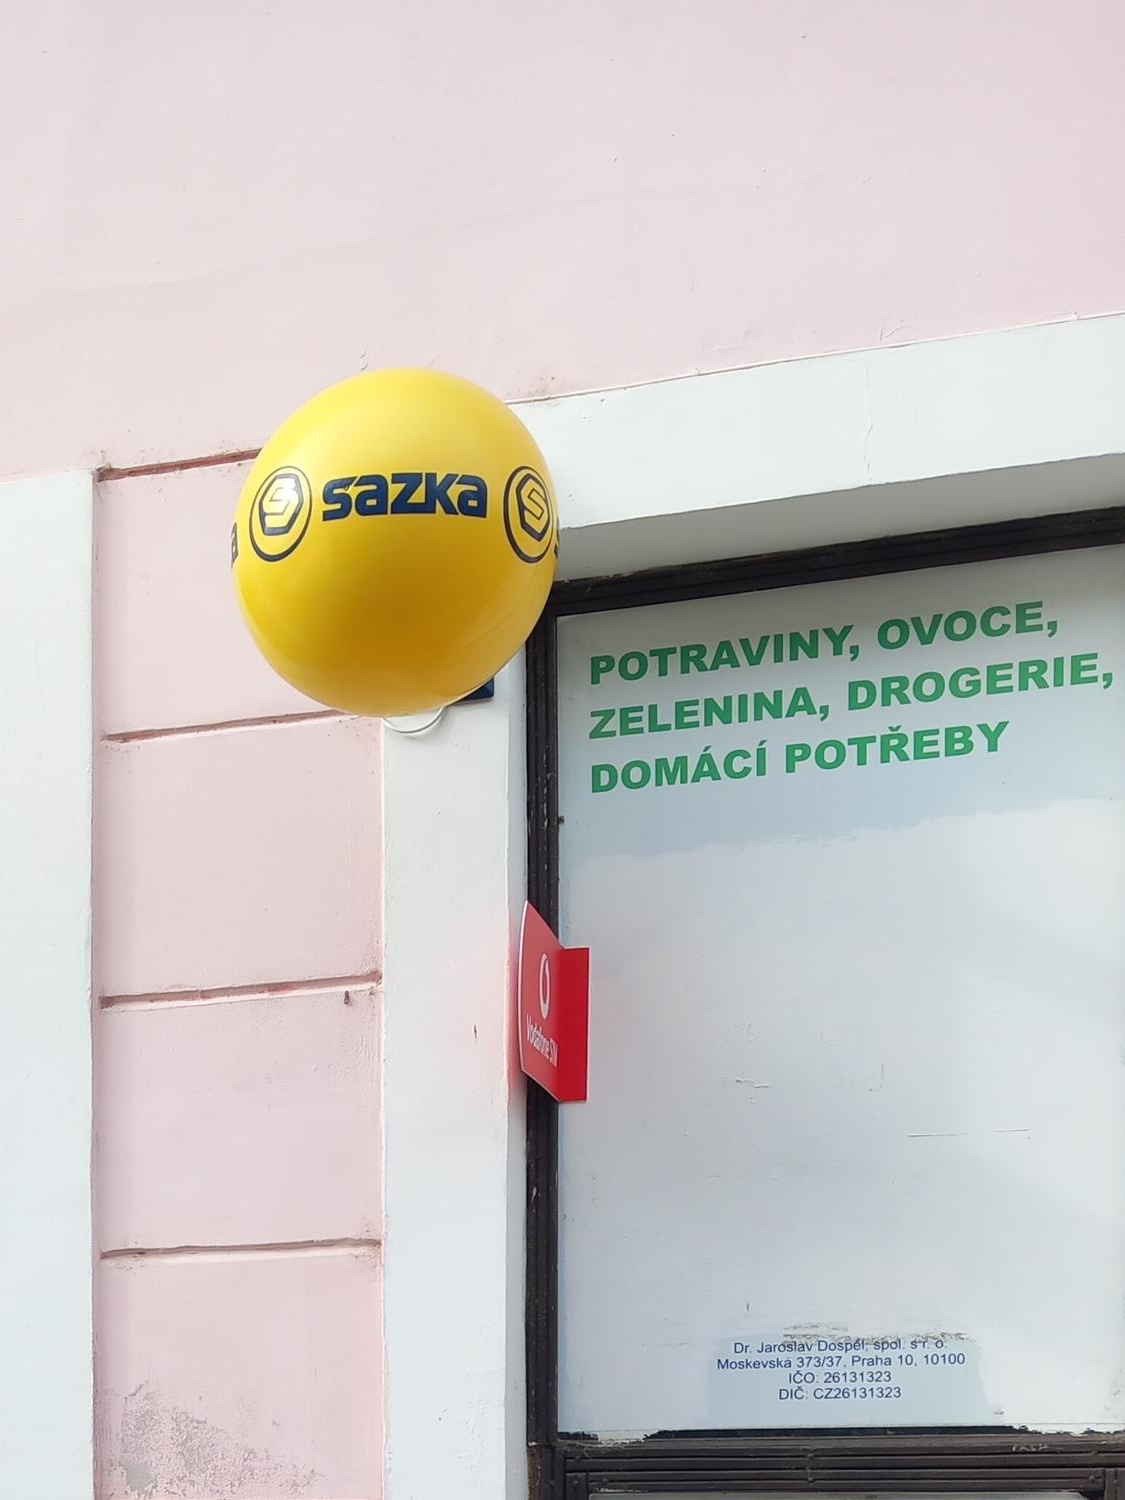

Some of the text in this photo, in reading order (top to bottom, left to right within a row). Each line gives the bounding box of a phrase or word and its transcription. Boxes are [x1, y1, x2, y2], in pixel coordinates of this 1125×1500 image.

[589, 600, 1059, 685] POTRAVINY, OVOCE,
[588, 652, 1114, 740] ZELENINA, DROGERIE,
[590, 720, 1010, 793] DOMÁCÍ POTŘEBY
[733, 1342, 752, 1354] Dr.
[756, 1340, 813, 1353] Jaroslav
[873, 1338, 905, 1352] spol.
[910, 1341, 918, 1350] s
[716, 1353, 966, 1370] Moskevská 373/37, Praha 10, 10100
[788, 1369, 892, 1384] IČO: 26131323
[778, 1386, 902, 1400] DIČ: CZ26131323
